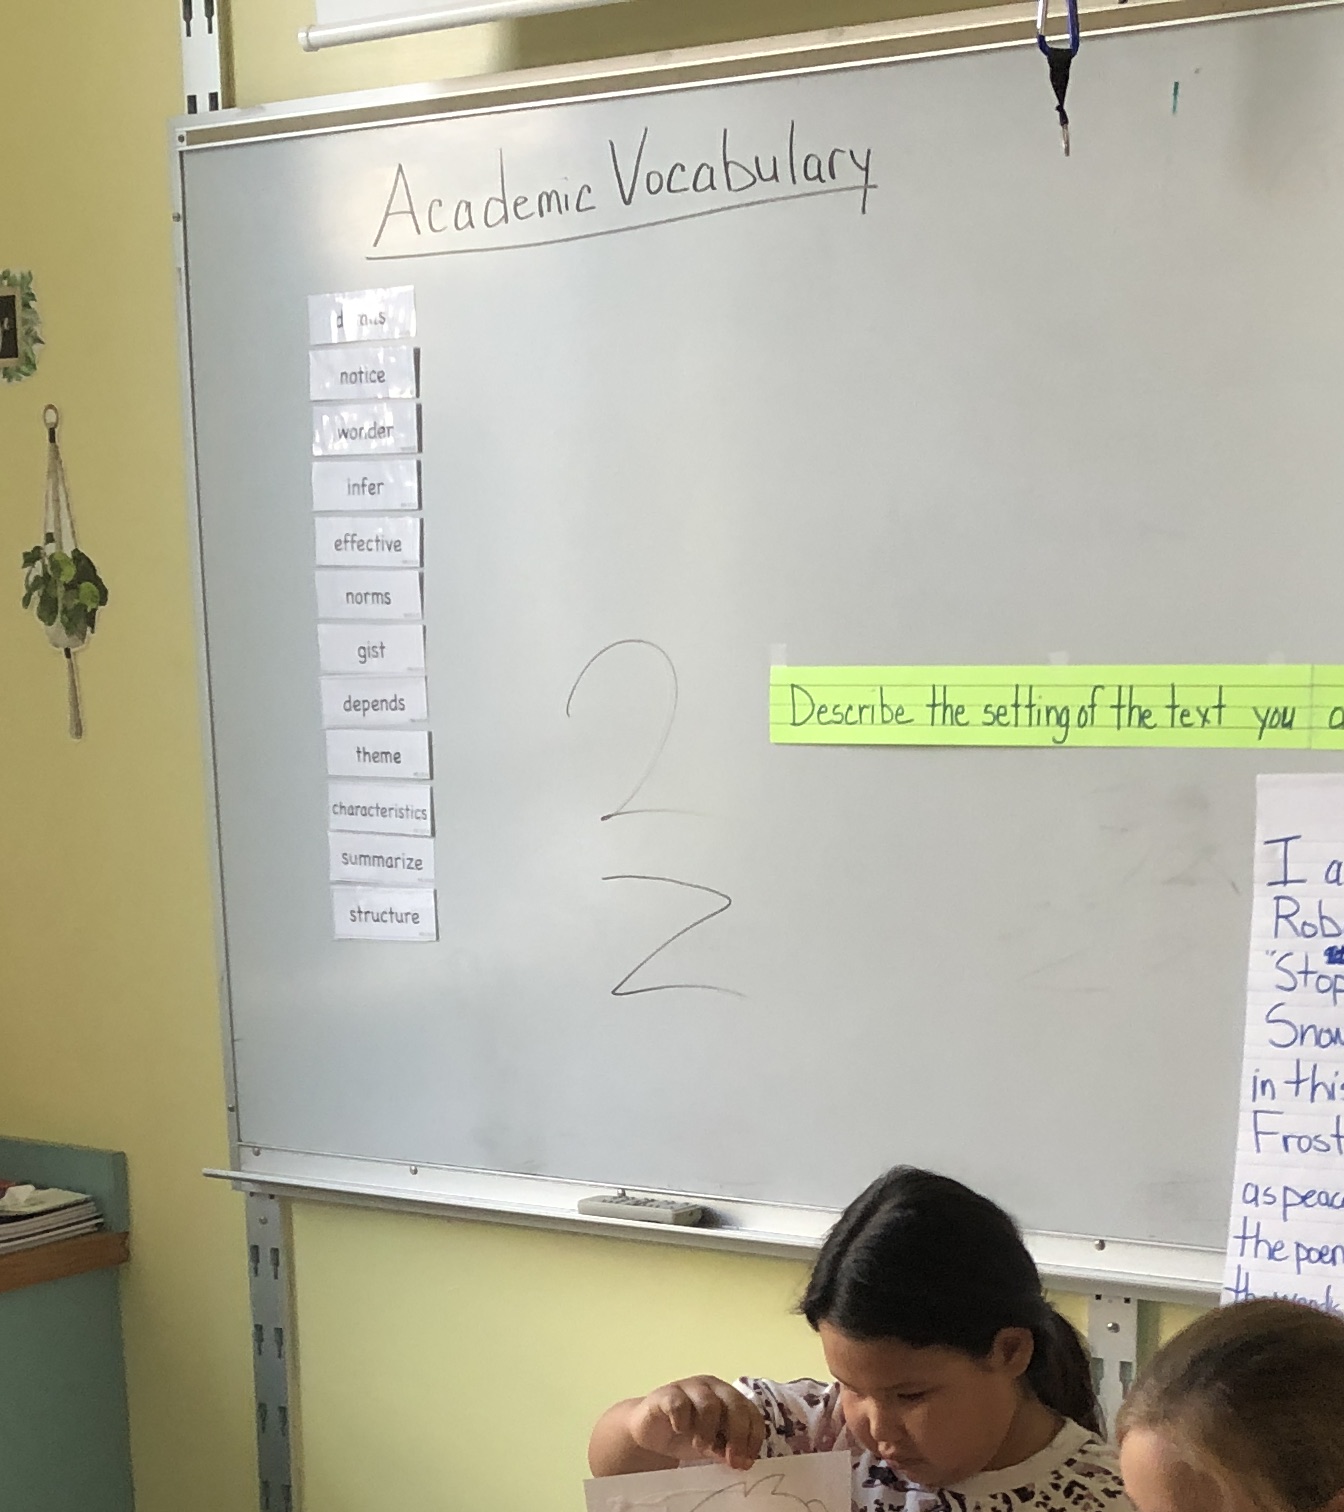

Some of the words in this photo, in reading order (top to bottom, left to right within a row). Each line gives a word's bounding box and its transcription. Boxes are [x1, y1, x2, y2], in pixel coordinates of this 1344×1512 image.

[373, 148, 597, 247] Academic
[609, 120, 872, 214] Vocabulary
[340, 367, 386, 384] notice
[337, 423, 394, 440] wonder
[347, 478, 384, 496] infer
[334, 533, 402, 552] effective
[346, 591, 391, 605] norms
[357, 641, 386, 664] gist
[343, 694, 405, 716] depends
[790, 683, 915, 727] Describe
[926, 683, 970, 727] the
[982, 683, 1069, 744] setting
[1077, 685, 1104, 727] of
[1111, 684, 1157, 729] the
[1165, 683, 1226, 728] text
[1252, 705, 1295, 741] you
[356, 746, 402, 764] theme
[332, 802, 427, 820] characteristics
[341, 852, 423, 871] summarize
[1264, 834, 1307, 887] I
[349, 908, 420, 924] structure
[1252, 1069, 1276, 1101] in
[1242, 1182, 1276, 1206] as
[1233, 1216, 1290, 1260] the
[1225, 1265, 1256, 1299] th
